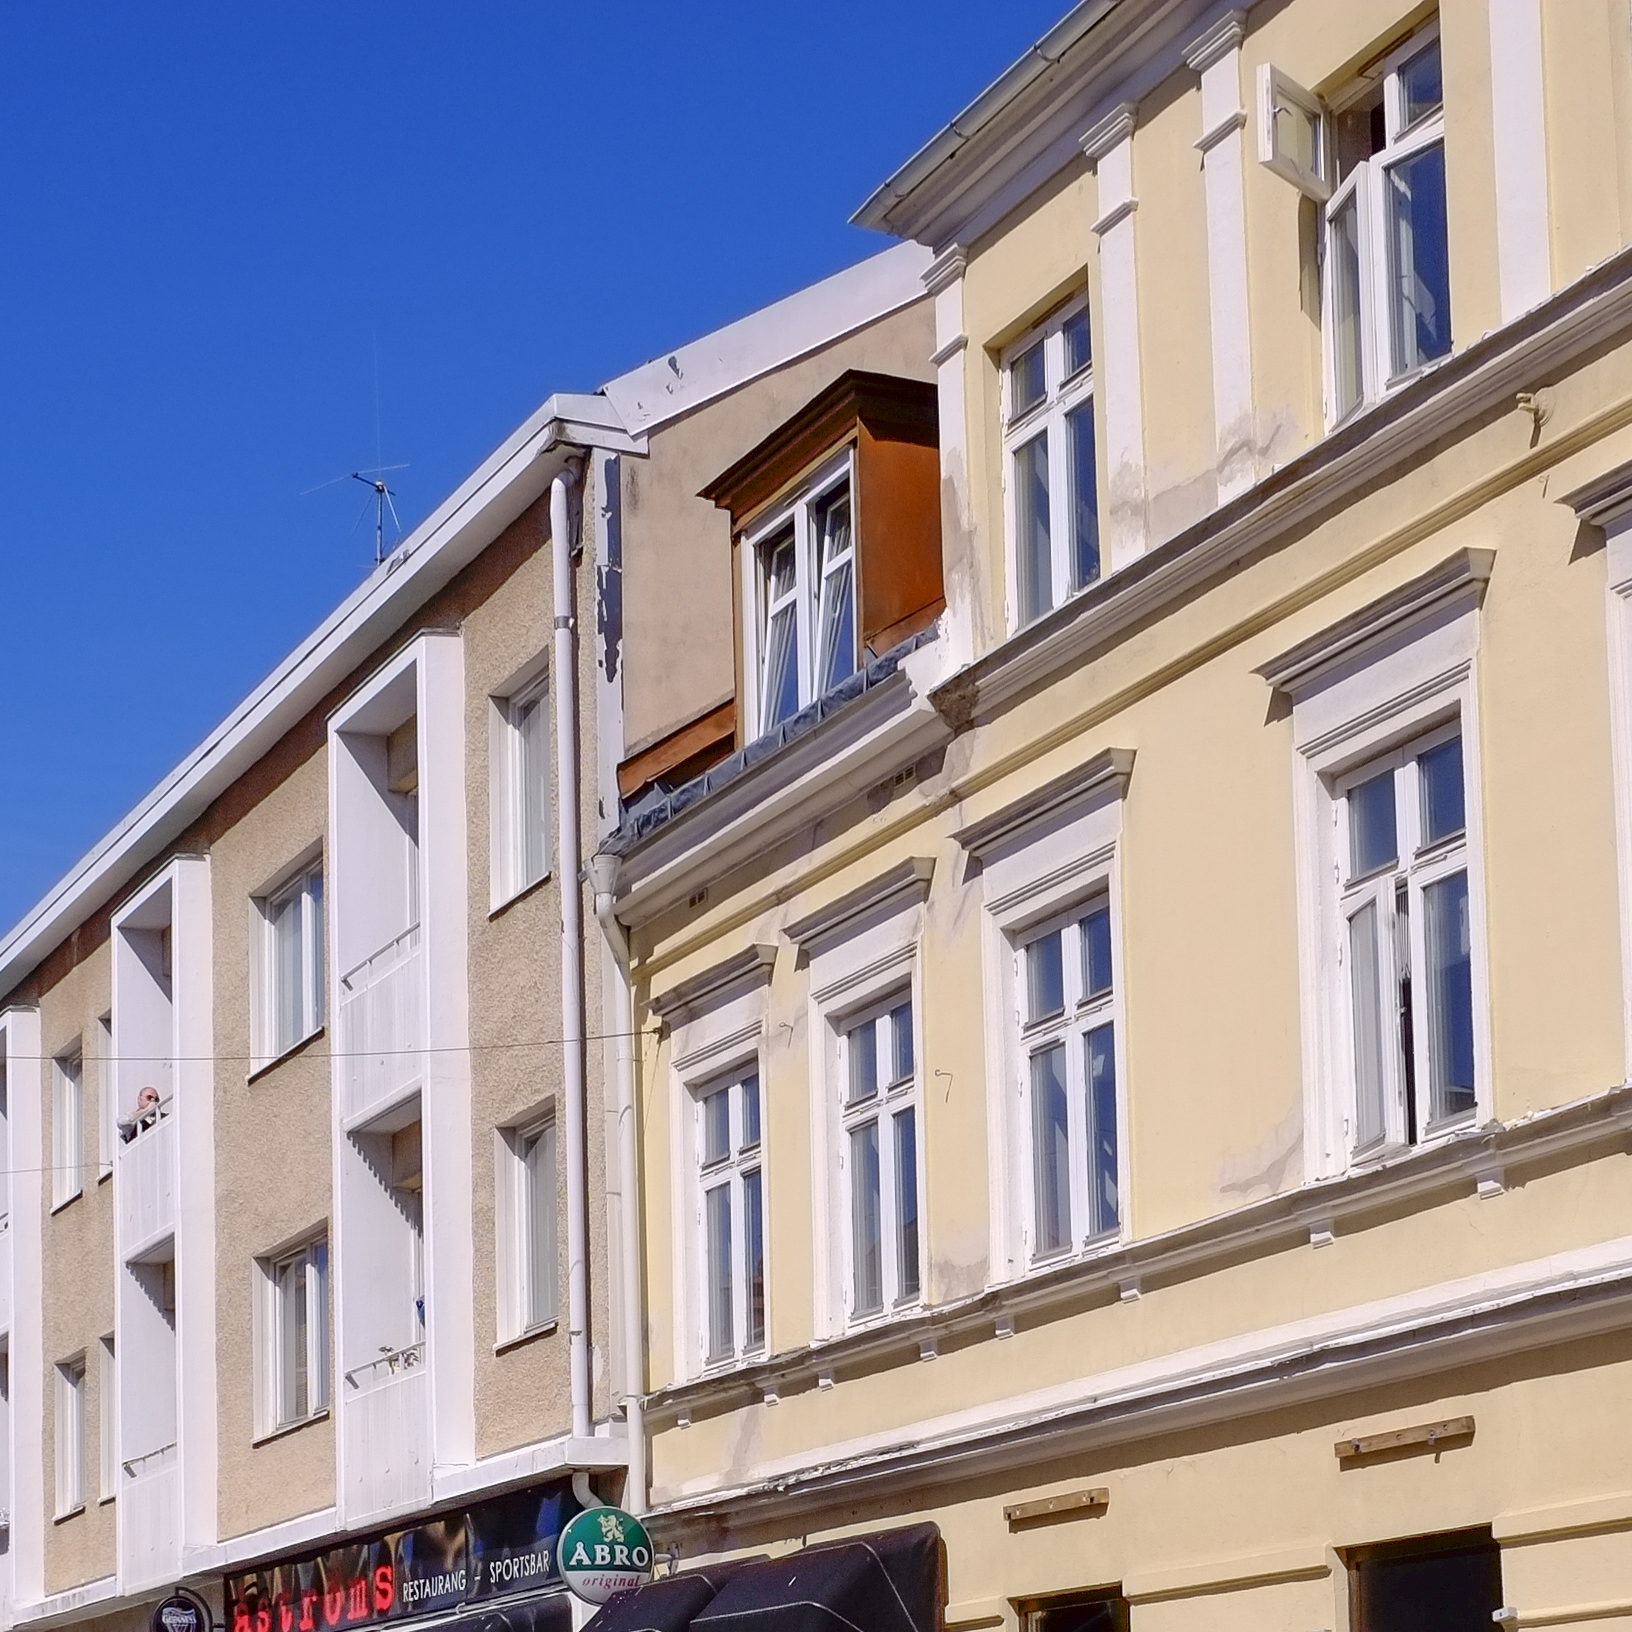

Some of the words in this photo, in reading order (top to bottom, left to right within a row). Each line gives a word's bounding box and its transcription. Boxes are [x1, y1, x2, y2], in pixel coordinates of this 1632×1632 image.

[568, 1541, 649, 1567] ÅBRO
[402, 1569, 467, 1602] RESTAURANG
[489, 1550, 550, 1584] SPORTSBAR
[582, 1574, 641, 1589] original
